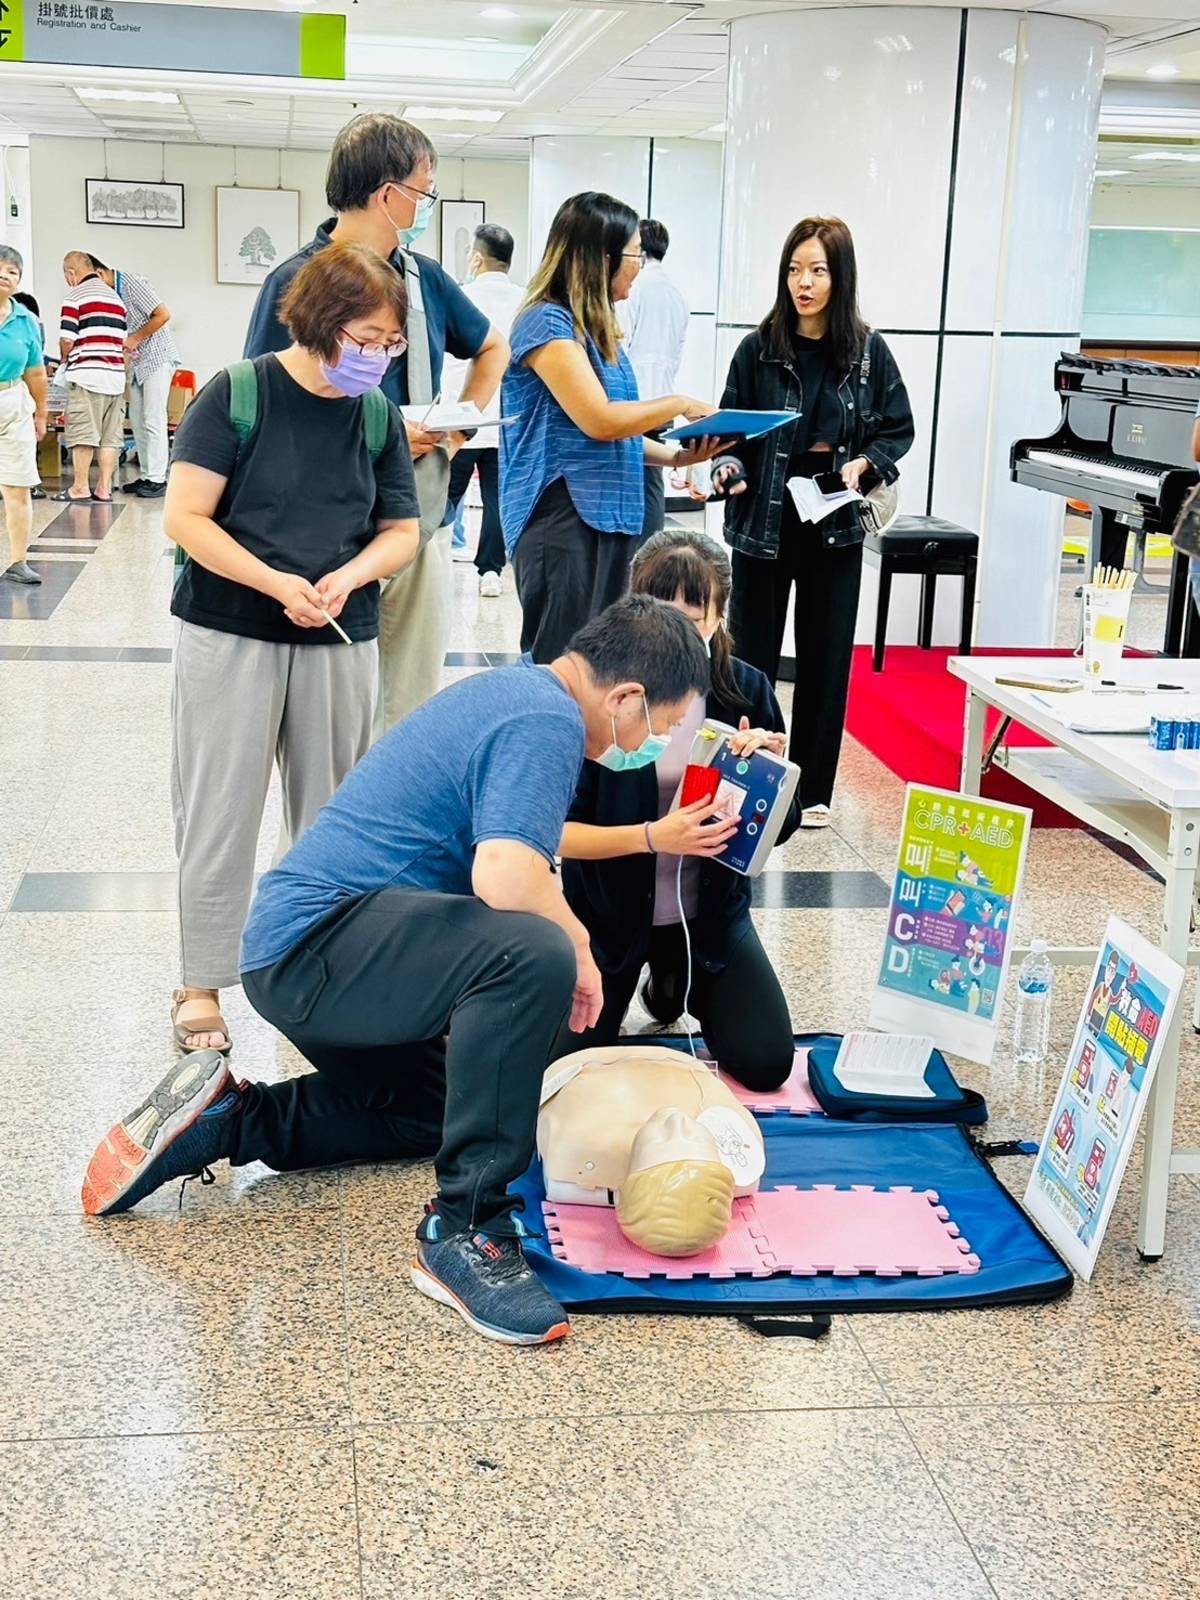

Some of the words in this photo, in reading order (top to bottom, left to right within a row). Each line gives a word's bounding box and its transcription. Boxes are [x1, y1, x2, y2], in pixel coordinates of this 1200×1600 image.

[37, 18, 87, 28] Registration
[90, 22, 106, 30] and
[110, 22, 142, 32] Cashier
[38, 2, 114, 21] 掛號批價處
[914, 808, 1014, 848] CPR+AED
[899, 878, 922, 907] 叫
[895, 913, 915, 940] C
[888, 945, 909, 973] D
